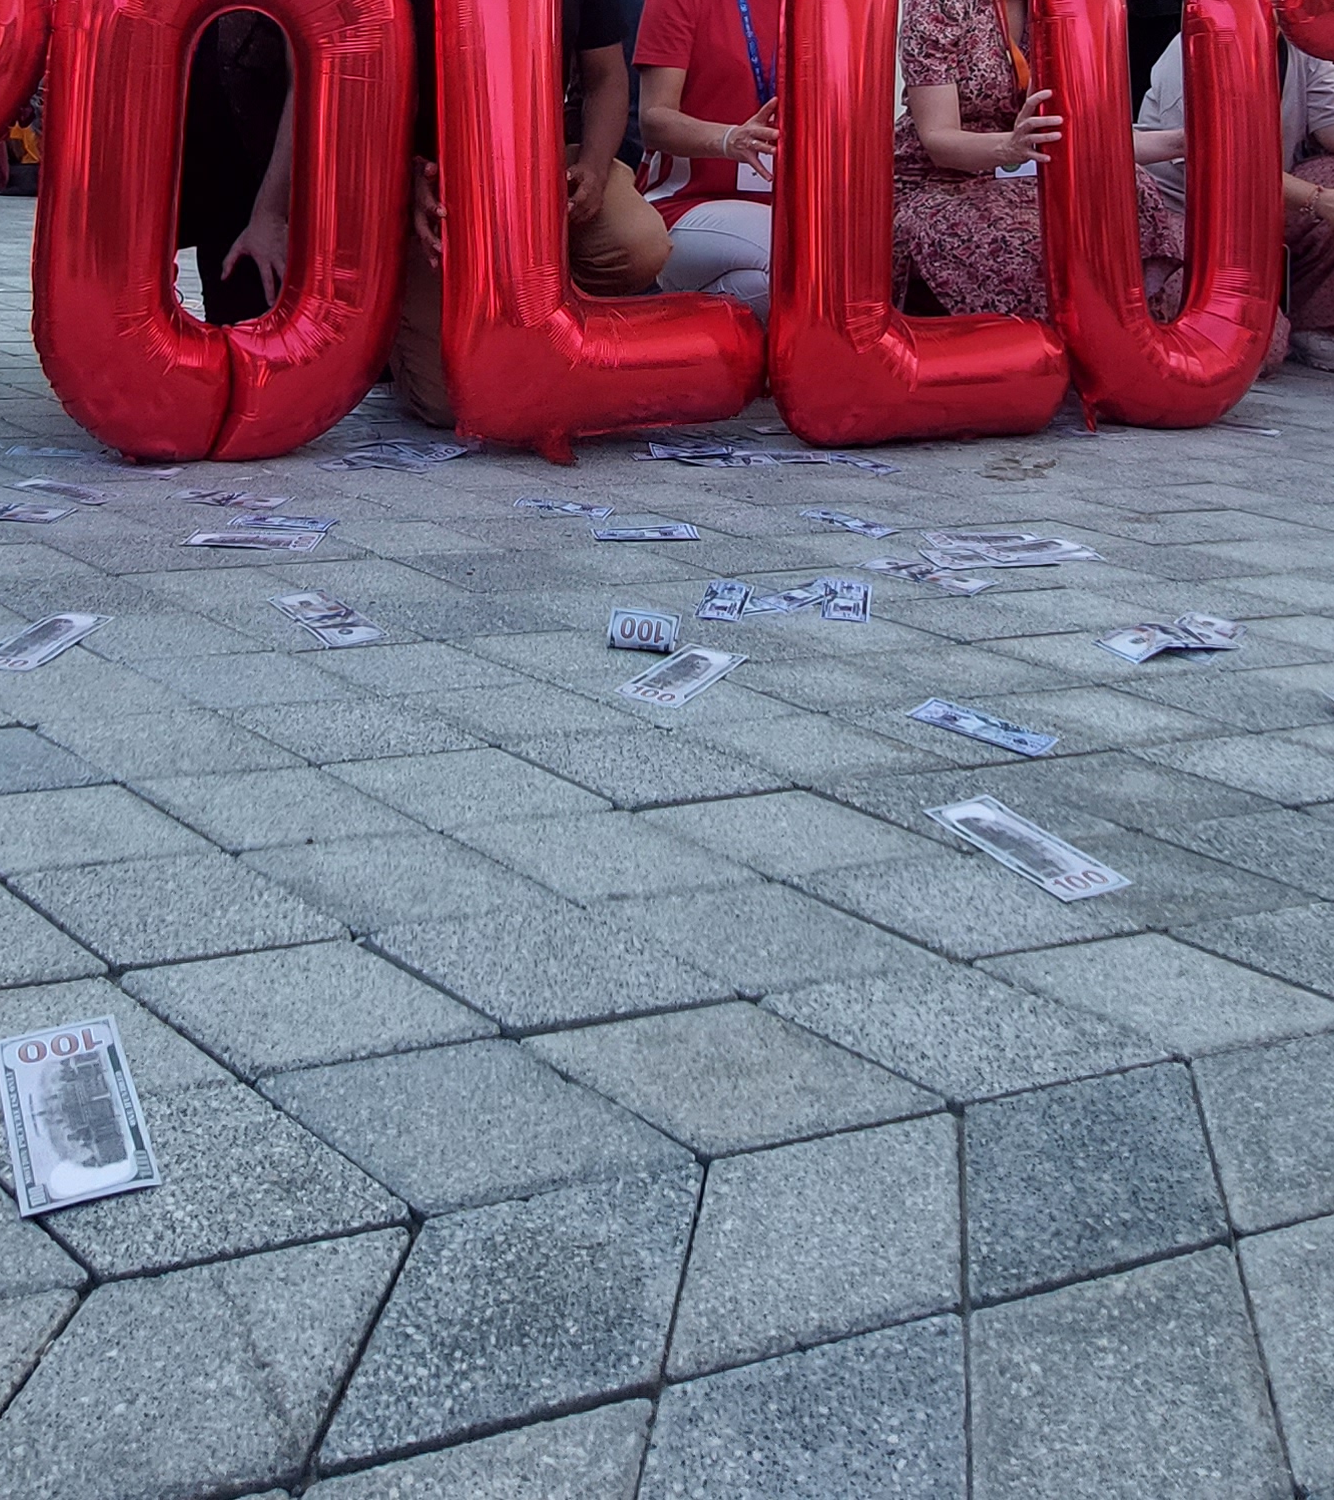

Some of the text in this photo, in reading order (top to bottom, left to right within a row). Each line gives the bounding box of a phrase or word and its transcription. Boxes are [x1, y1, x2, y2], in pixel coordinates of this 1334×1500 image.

[620, 617, 665, 644] 100
[633, 686, 677, 702] 100
[1053, 870, 1109, 892] 100
[18, 1028, 103, 1064] 100
